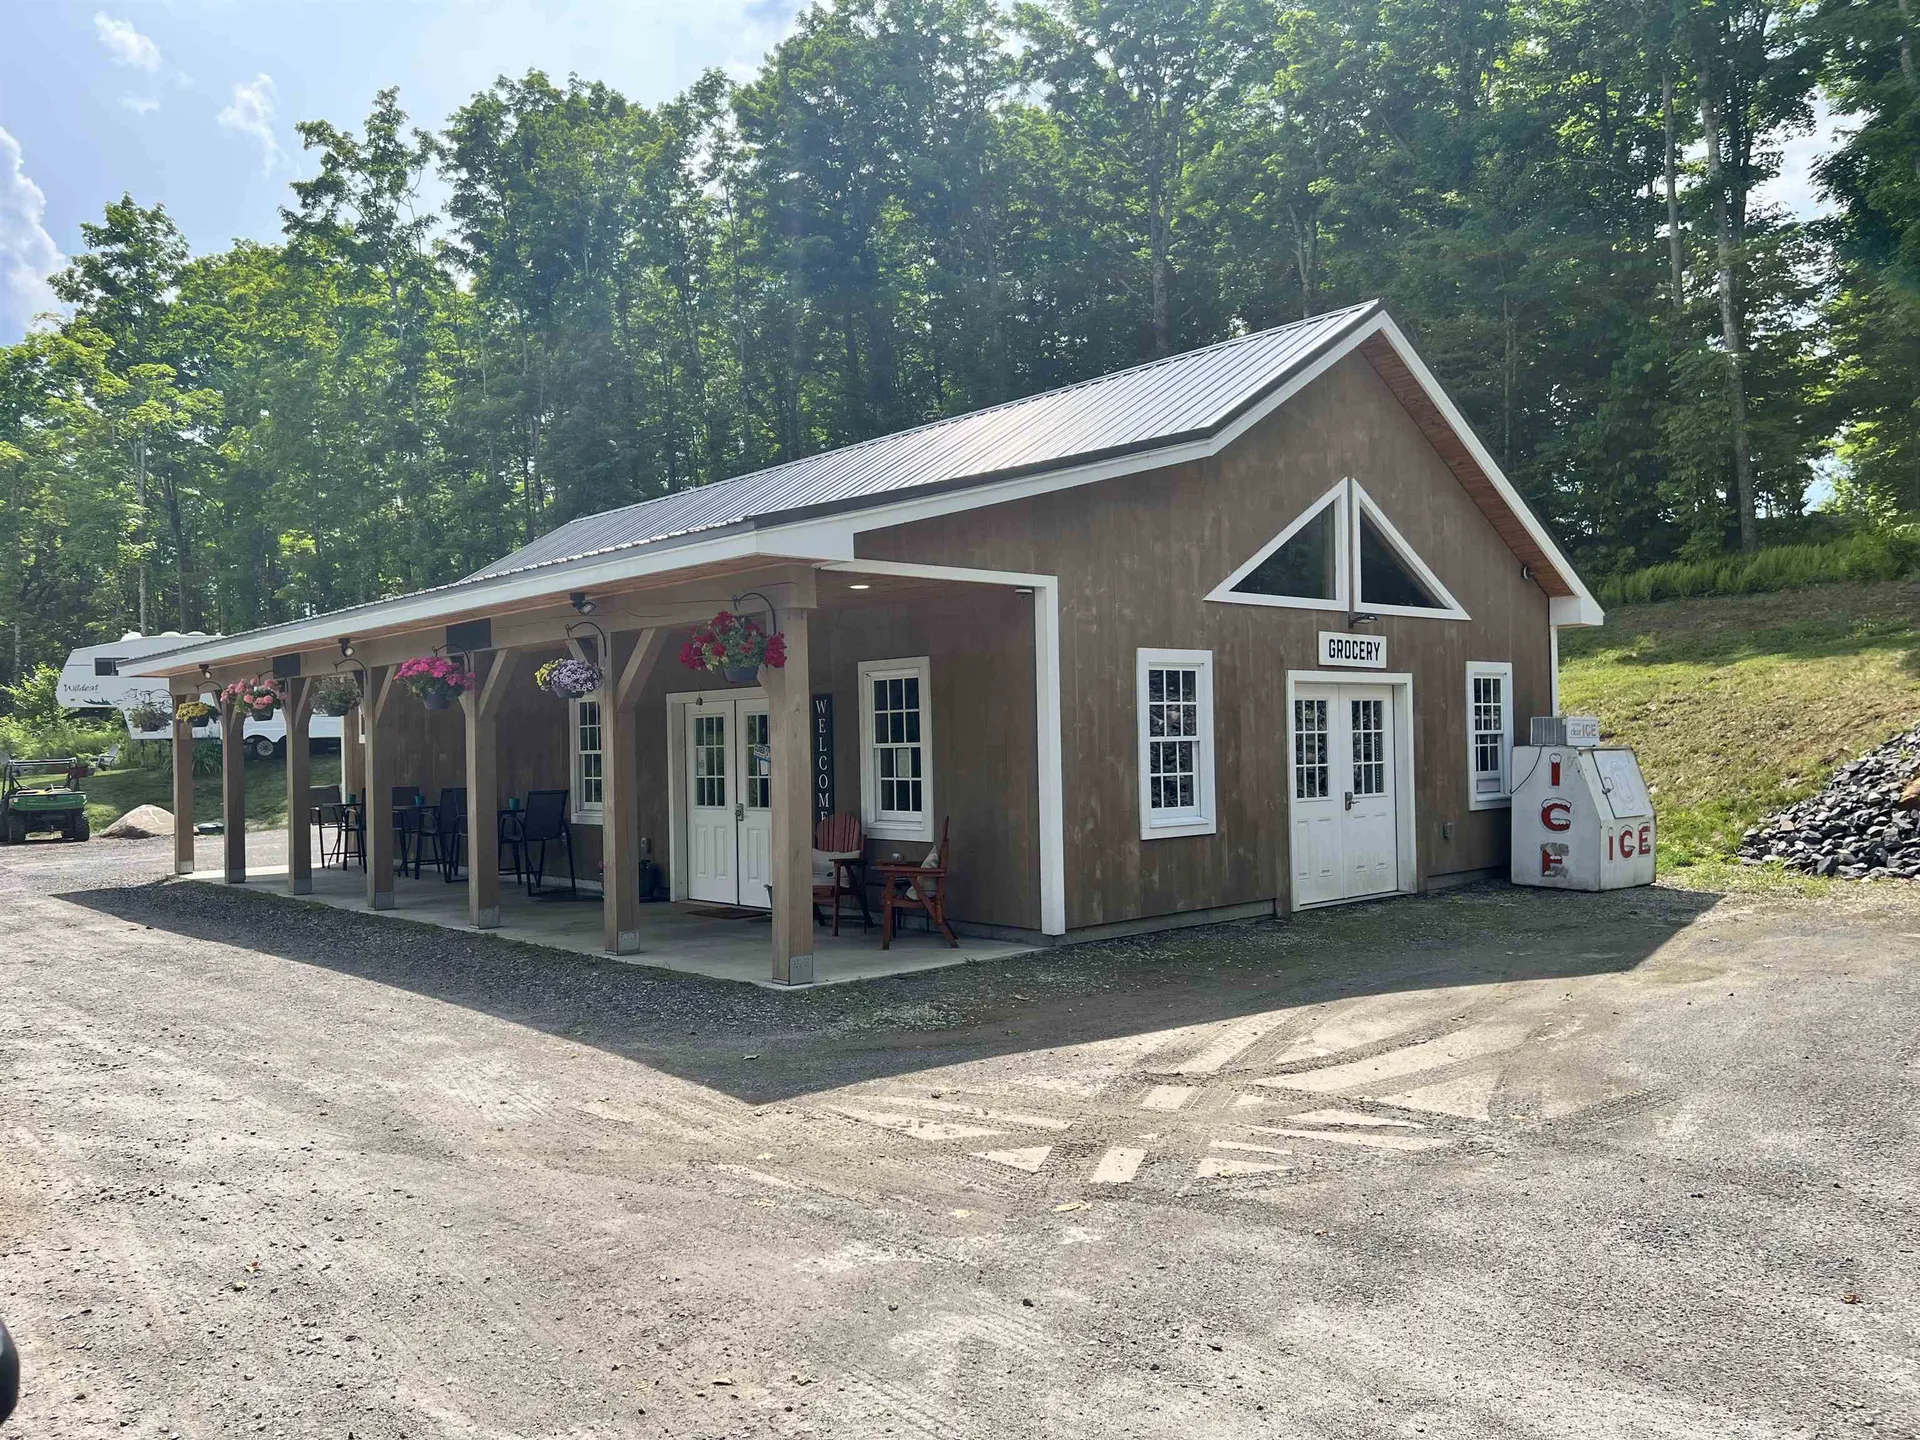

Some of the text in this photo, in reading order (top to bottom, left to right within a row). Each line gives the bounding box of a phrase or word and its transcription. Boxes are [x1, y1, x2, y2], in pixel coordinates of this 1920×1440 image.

[1329, 638, 1380, 661] GROCERY
[1582, 723, 1597, 737] ICE
[1608, 820, 1651, 862] ICE
